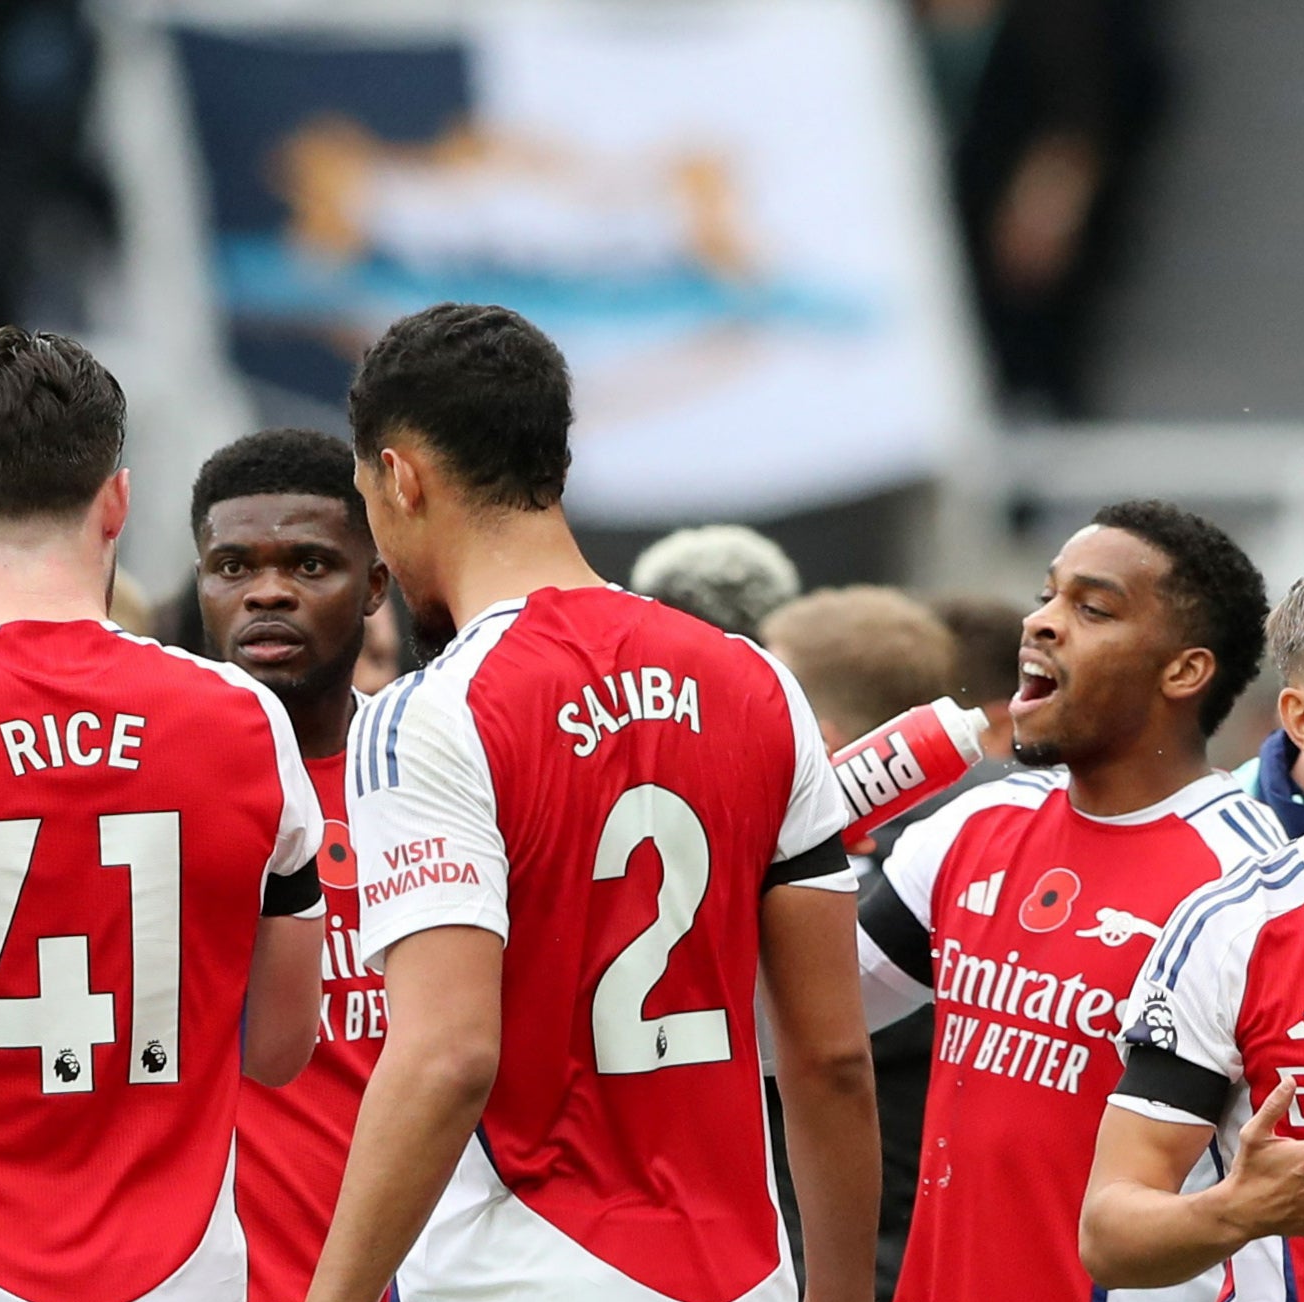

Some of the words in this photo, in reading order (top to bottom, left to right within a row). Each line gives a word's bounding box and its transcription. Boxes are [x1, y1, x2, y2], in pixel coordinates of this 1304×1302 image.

[0, 711, 146, 776] RICE
[835, 731, 926, 829] PRI
[363, 862, 481, 907] RWANDA
[383, 837, 447, 870] VISIT
[593, 783, 731, 1074] 2
[972, 1021, 1091, 1095] BETTER
